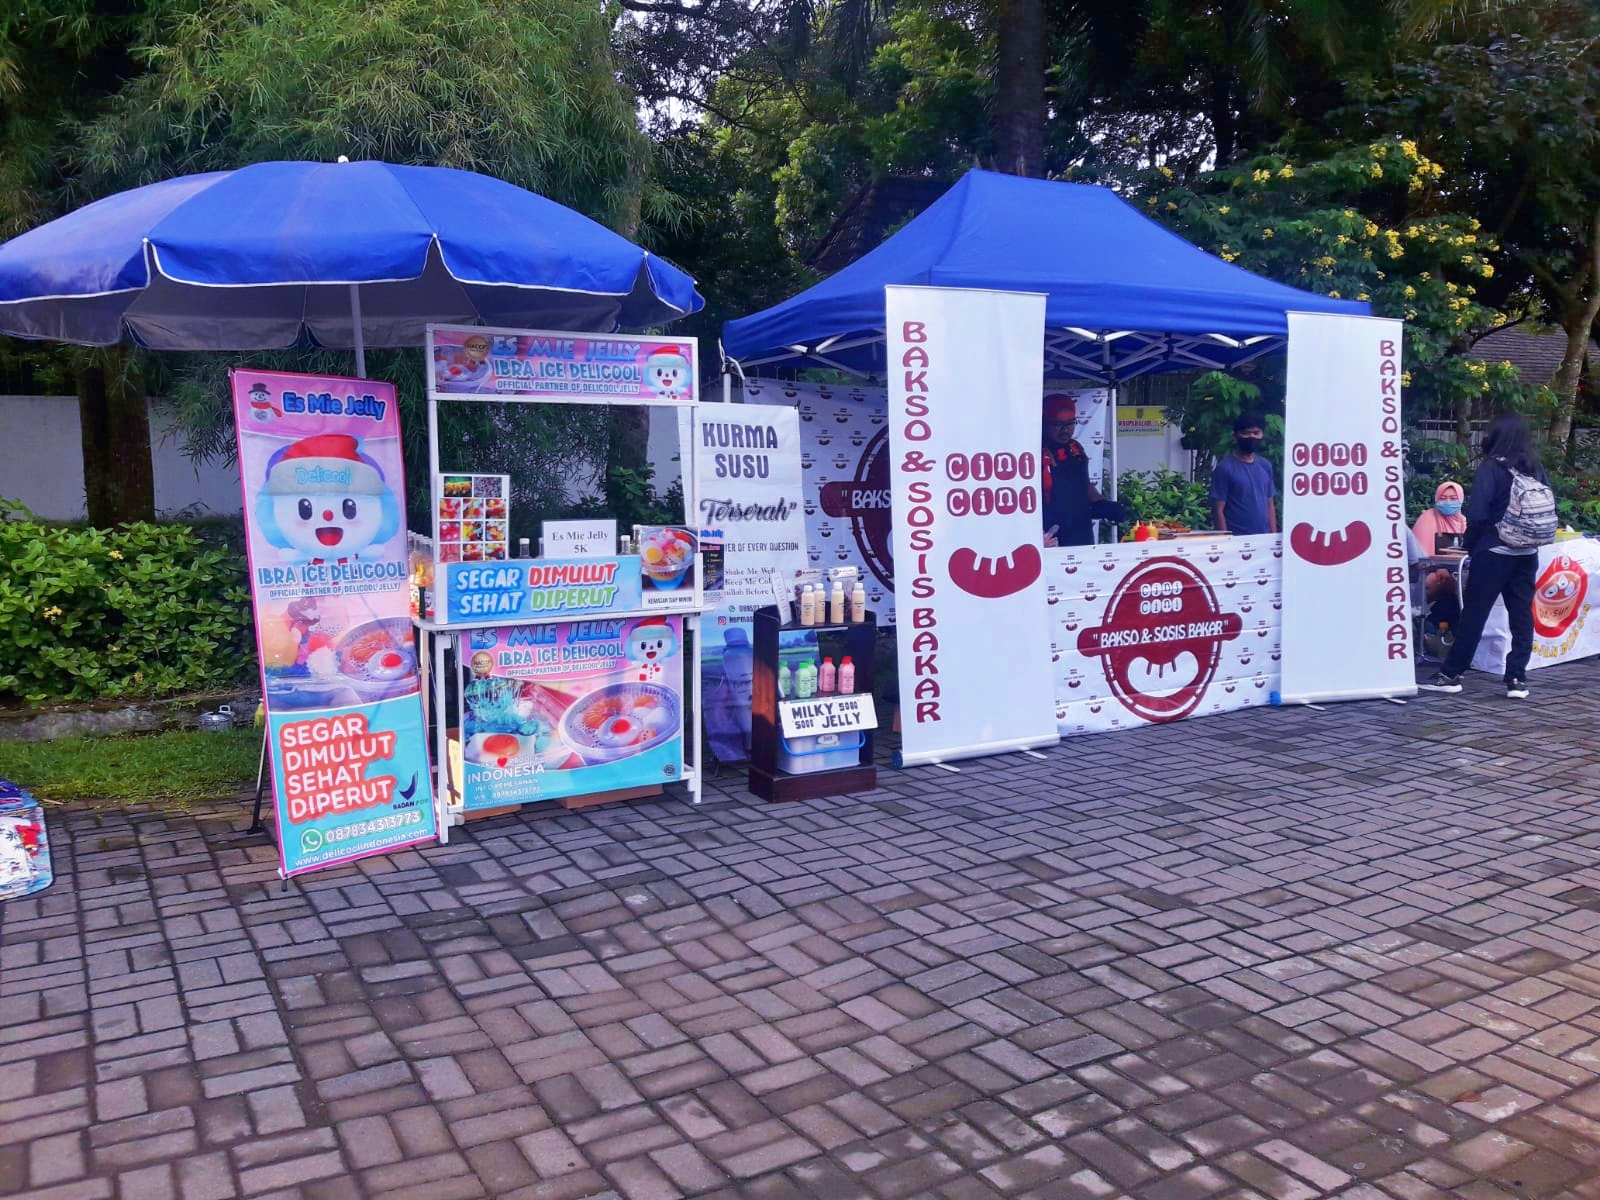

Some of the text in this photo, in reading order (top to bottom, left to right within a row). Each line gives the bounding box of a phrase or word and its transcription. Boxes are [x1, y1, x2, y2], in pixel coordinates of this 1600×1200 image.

[492, 336, 640, 361] ES MIE JELLY
[494, 360, 641, 381] IBRA ICE DELICOOL
[497, 381, 639, 393] OFFICIAL PARTNER OF DELICOOL JELLY
[283, 392, 386, 421] Es Mie Jelly
[702, 423, 778, 449] KURMA
[715, 453, 770, 479] SUSU
[1380, 340, 1407, 659] BAKSO & SOSIS BAKAR
[901, 322, 941, 723] BAKSO & SOSIS BAKAR
[552, 531, 608, 541] Es Mie Jelly
[738, 543, 746, 552] OF
[748, 543, 768, 552] EVERY
[769, 542, 799, 551] QUESTION
[574, 544, 588, 553] 5K
[258, 561, 406, 585] IBRA ICE DELICOOL
[456, 563, 618, 591] SEGAR DIMULUT
[759, 577, 771, 585] Col
[270, 582, 398, 598] OFFICIAL PARTNER OF DELICOOL JELLY
[460, 586, 618, 615] SEHAT DIPERUT
[470, 620, 626, 650] ES MIE JELLY
[1141, 628, 1152, 643] &
[1154, 626, 1185, 642] SOSIS
[499, 643, 624, 666] IBRA ICE DELICOOL
[572, 663, 599, 671] DELICOOL
[792, 701, 859, 719] MILKY 5000
[822, 712, 860, 728] JELLY
[283, 717, 364, 748] SEGAR
[285, 735, 392, 772] DIMULUT
[287, 763, 362, 795] SEHAT
[467, 764, 545, 785] INDONESIA
[291, 780, 392, 819] DIPERUT
[295, 828, 428, 867] www.delicoolindonesia.com
